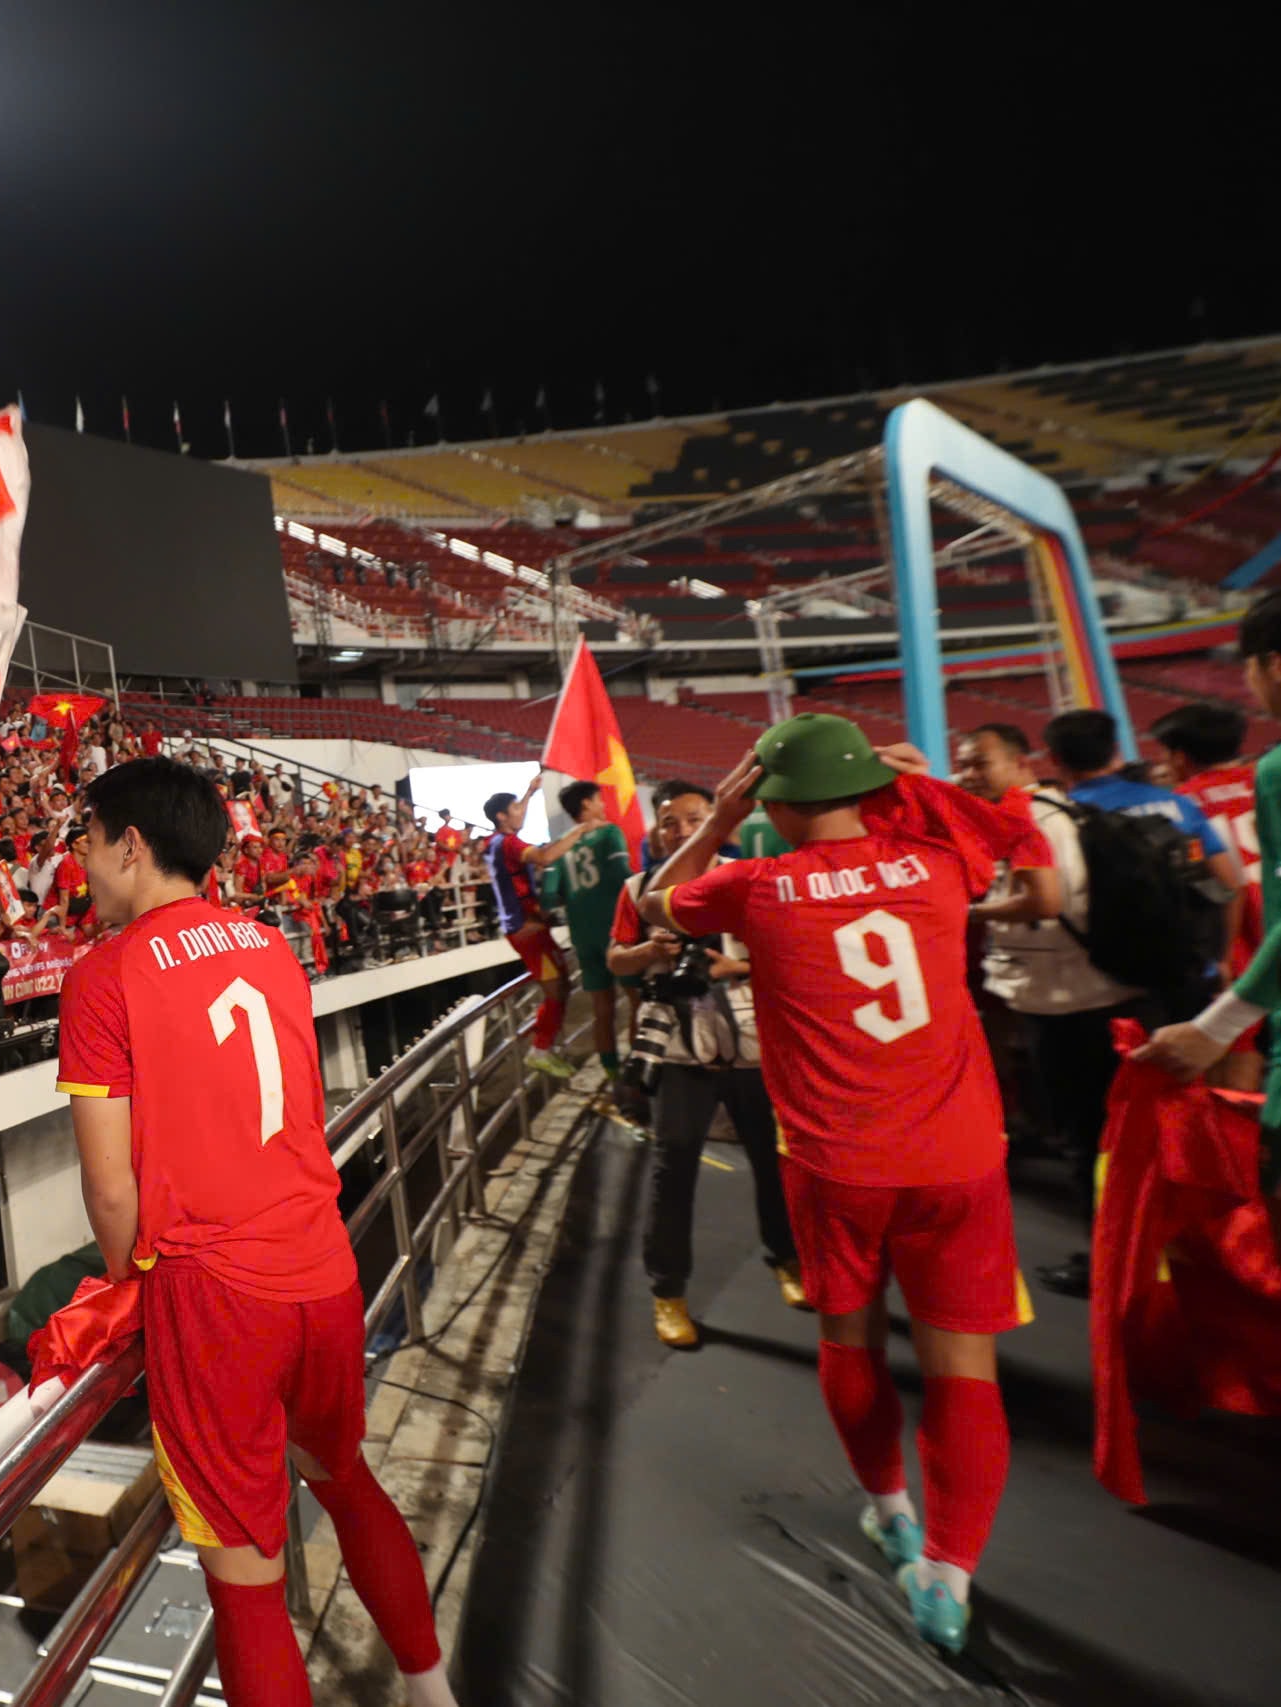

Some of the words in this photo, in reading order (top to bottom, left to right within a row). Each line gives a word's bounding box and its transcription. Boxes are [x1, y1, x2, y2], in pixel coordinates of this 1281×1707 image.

[563, 846, 601, 892] 13
[807, 866, 876, 900] QUOC
[227, 922, 270, 949] BAC
[35, 975, 55, 993] U22
[833, 909, 931, 1044] 9
[207, 976, 284, 1146] 7
